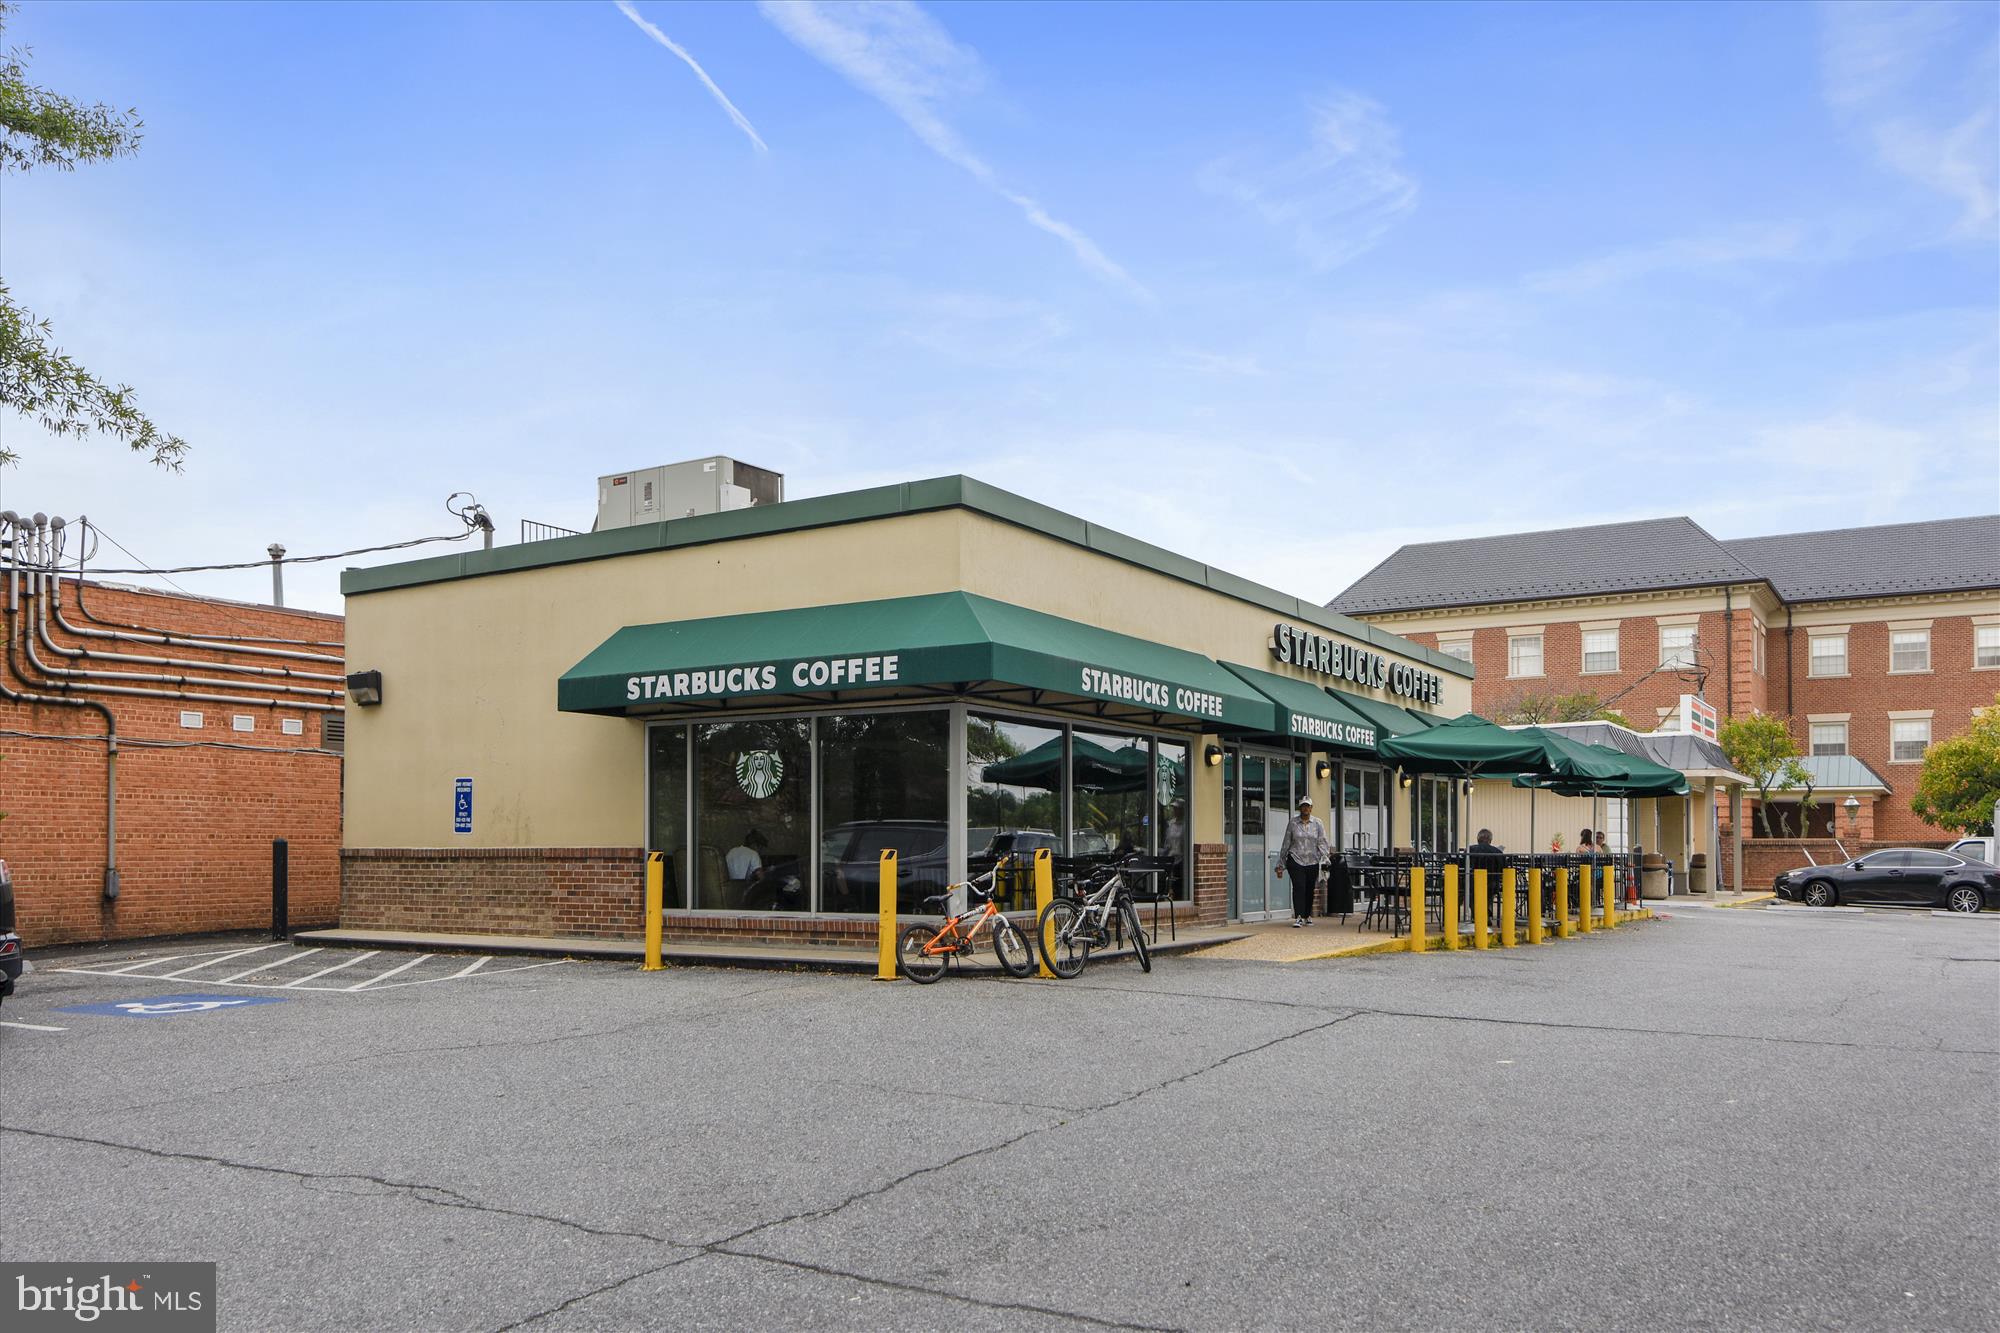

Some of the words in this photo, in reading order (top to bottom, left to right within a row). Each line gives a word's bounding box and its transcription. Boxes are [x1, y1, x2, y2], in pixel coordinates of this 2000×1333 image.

[626, 665, 777, 700] STARBUCKS
[792, 655, 899, 687] COFFEE
[1276, 623, 1386, 690] STARBUCKS
[1391, 662, 1444, 705] COFFEE
[1081, 667, 1169, 707] STARBUCKS
[1176, 688, 1223, 717] COFFEE
[1291, 713, 1343, 741] STARBUCKS
[1345, 725, 1375, 746] COFFEE
